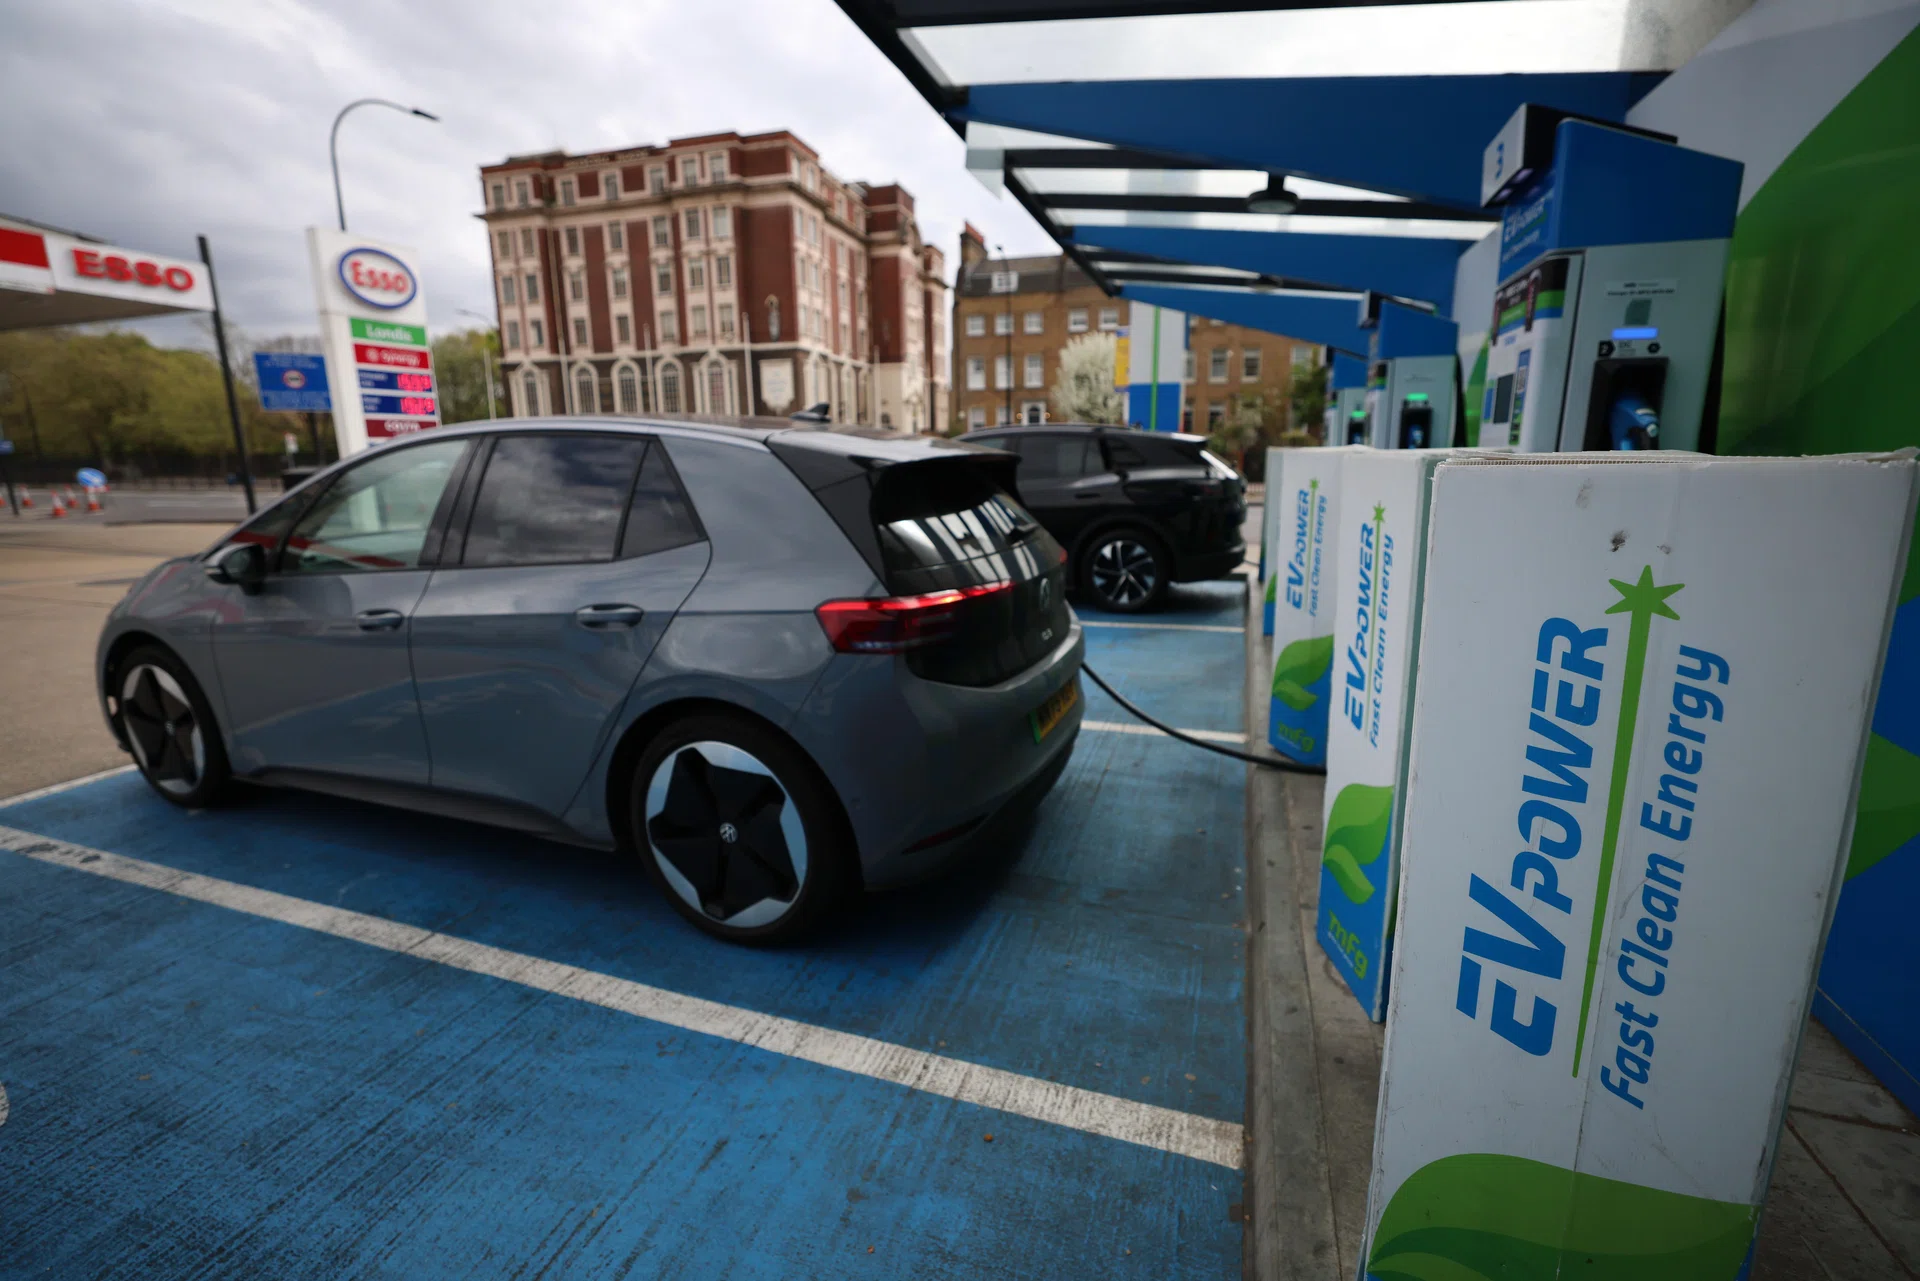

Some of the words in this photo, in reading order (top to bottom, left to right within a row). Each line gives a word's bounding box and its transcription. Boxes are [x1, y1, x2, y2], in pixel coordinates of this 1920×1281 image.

[350, 260, 408, 293] Esso
[1315, 495, 1327, 544] Energy
[1379, 534, 1394, 622] Energy
[1373, 628, 1386, 694] Clean
[1369, 698, 1381, 748] Fast
[1640, 644, 1731, 842] Energy
[1617, 853, 1685, 998] Clean
[1600, 1001, 1659, 1110] Fast
